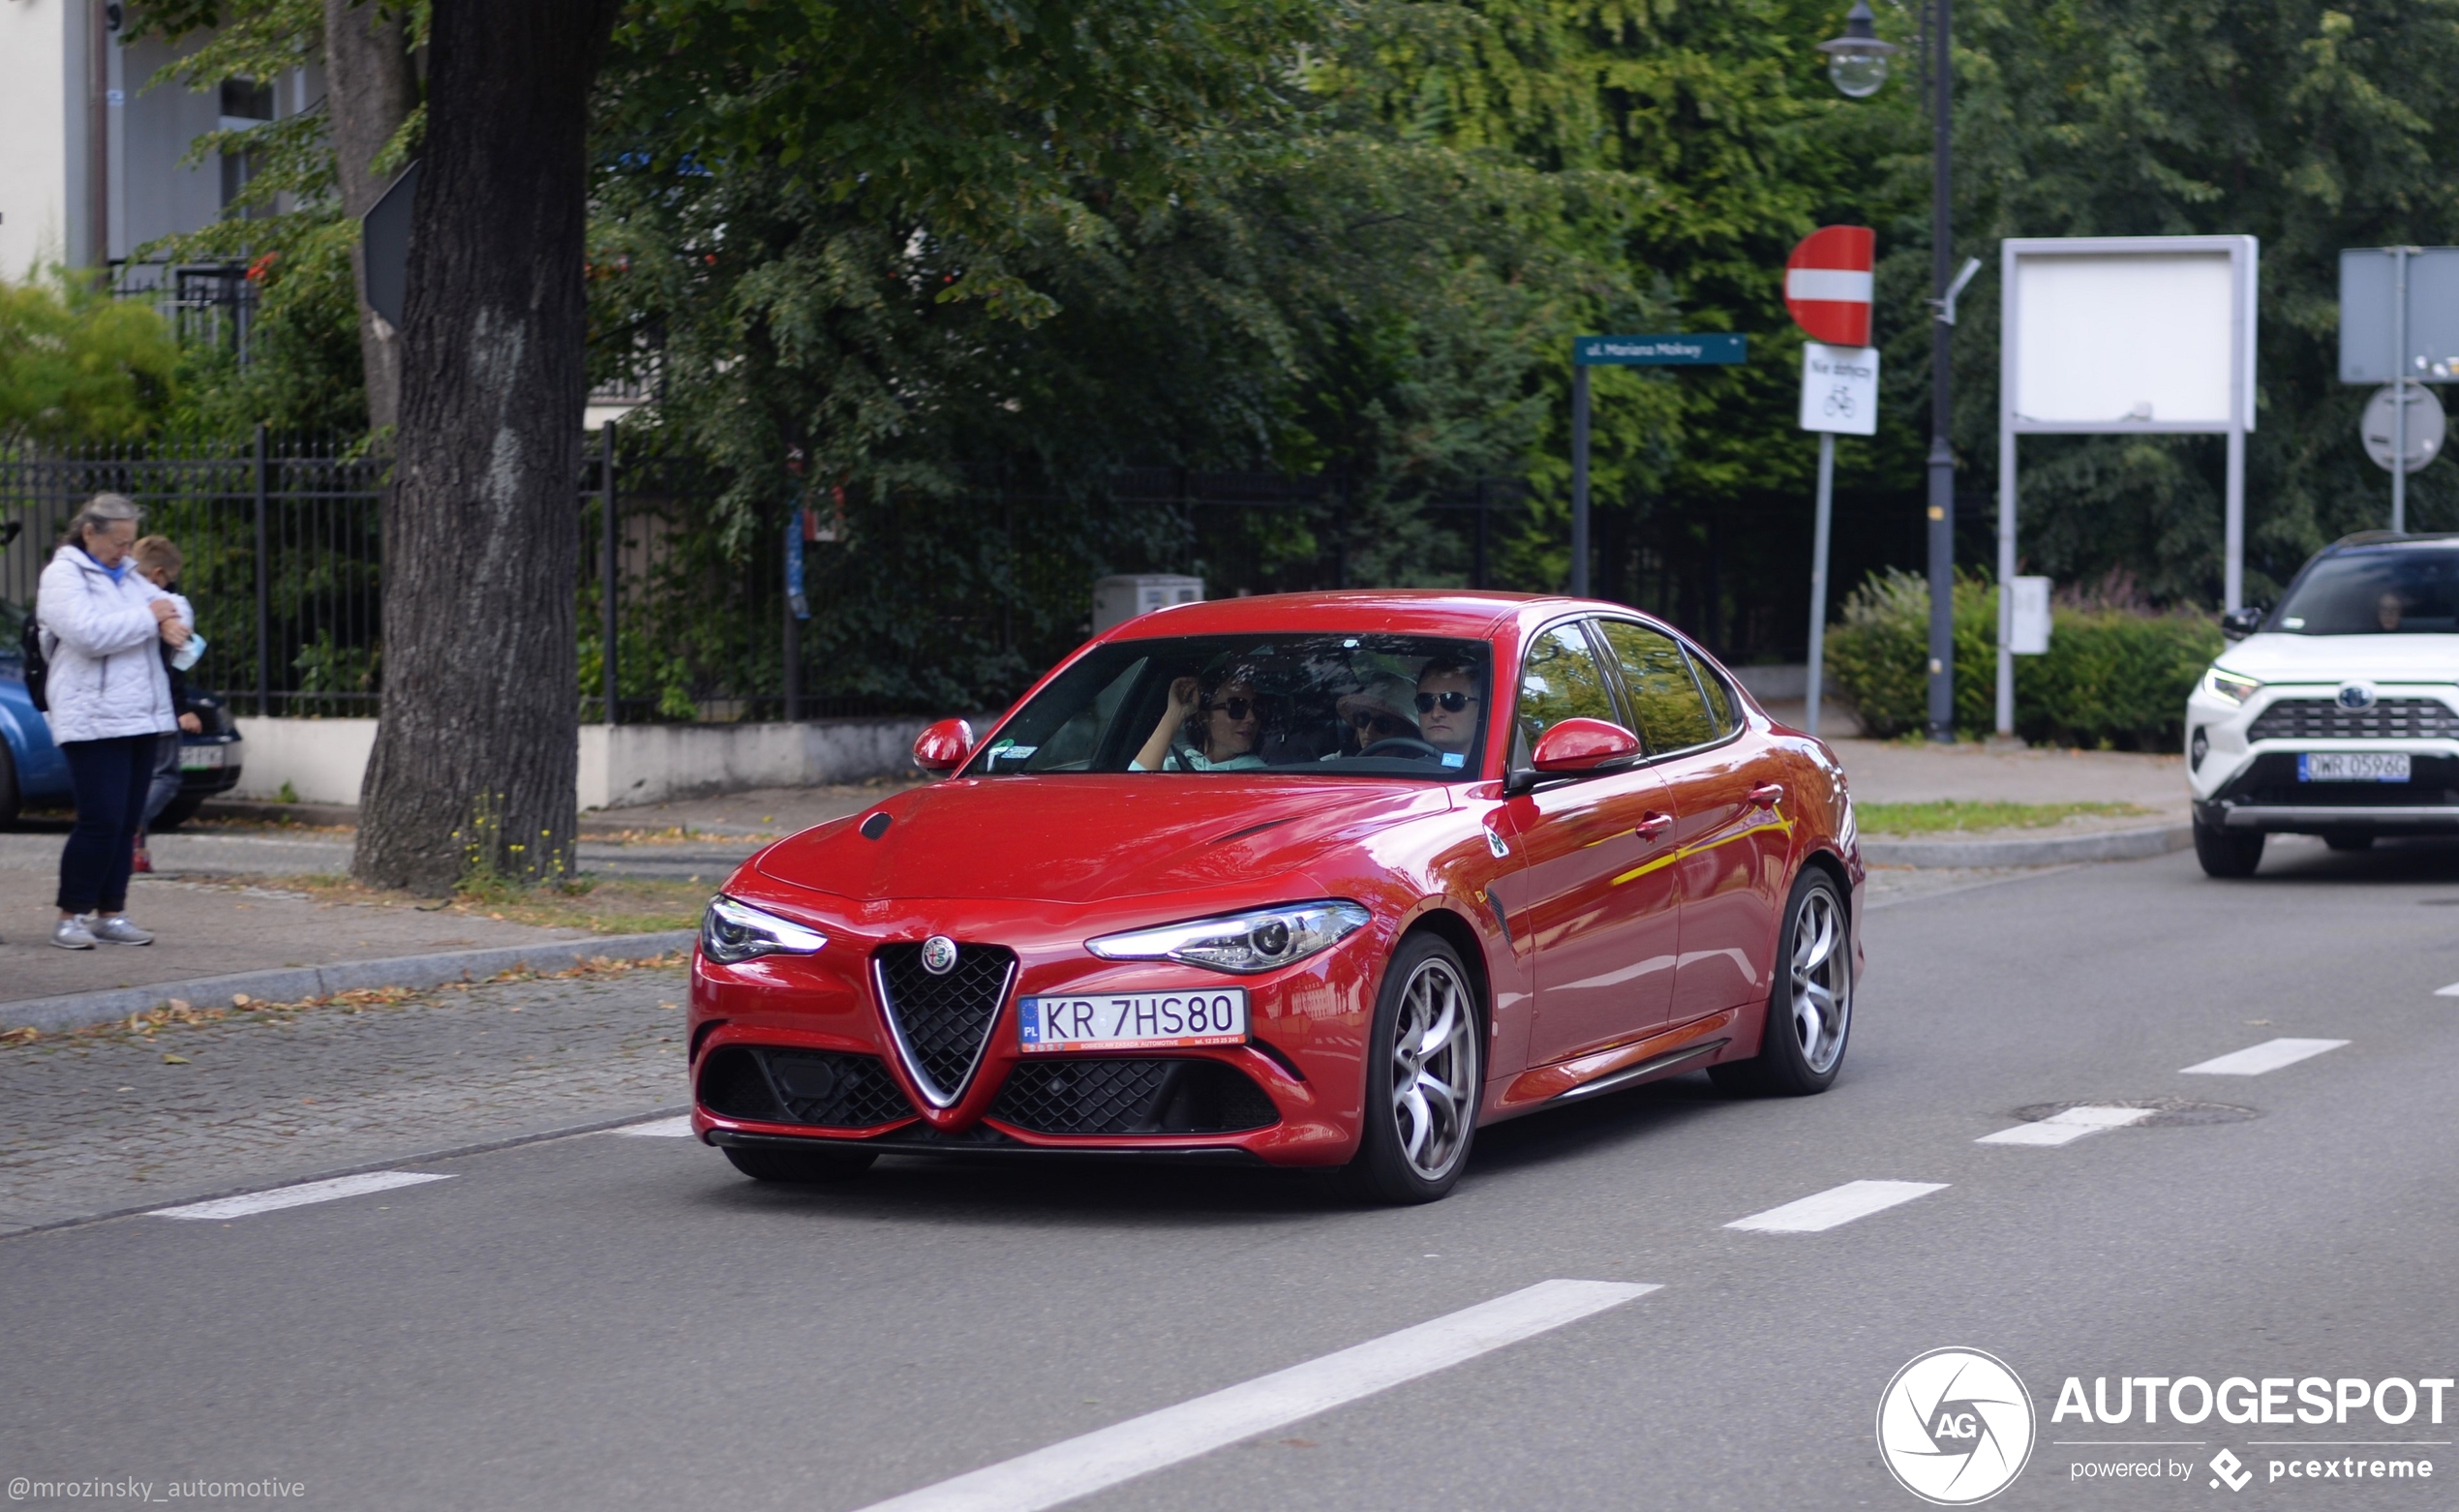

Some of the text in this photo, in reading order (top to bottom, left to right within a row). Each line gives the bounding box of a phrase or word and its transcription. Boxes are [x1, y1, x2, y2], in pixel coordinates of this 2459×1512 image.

[1604, 343, 1654, 356] Mariana
[1811, 358, 1872, 380] Nie dotyczy
[1047, 995, 1233, 1039] KR 7HS80
[1024, 1027, 1038, 1037] PL
